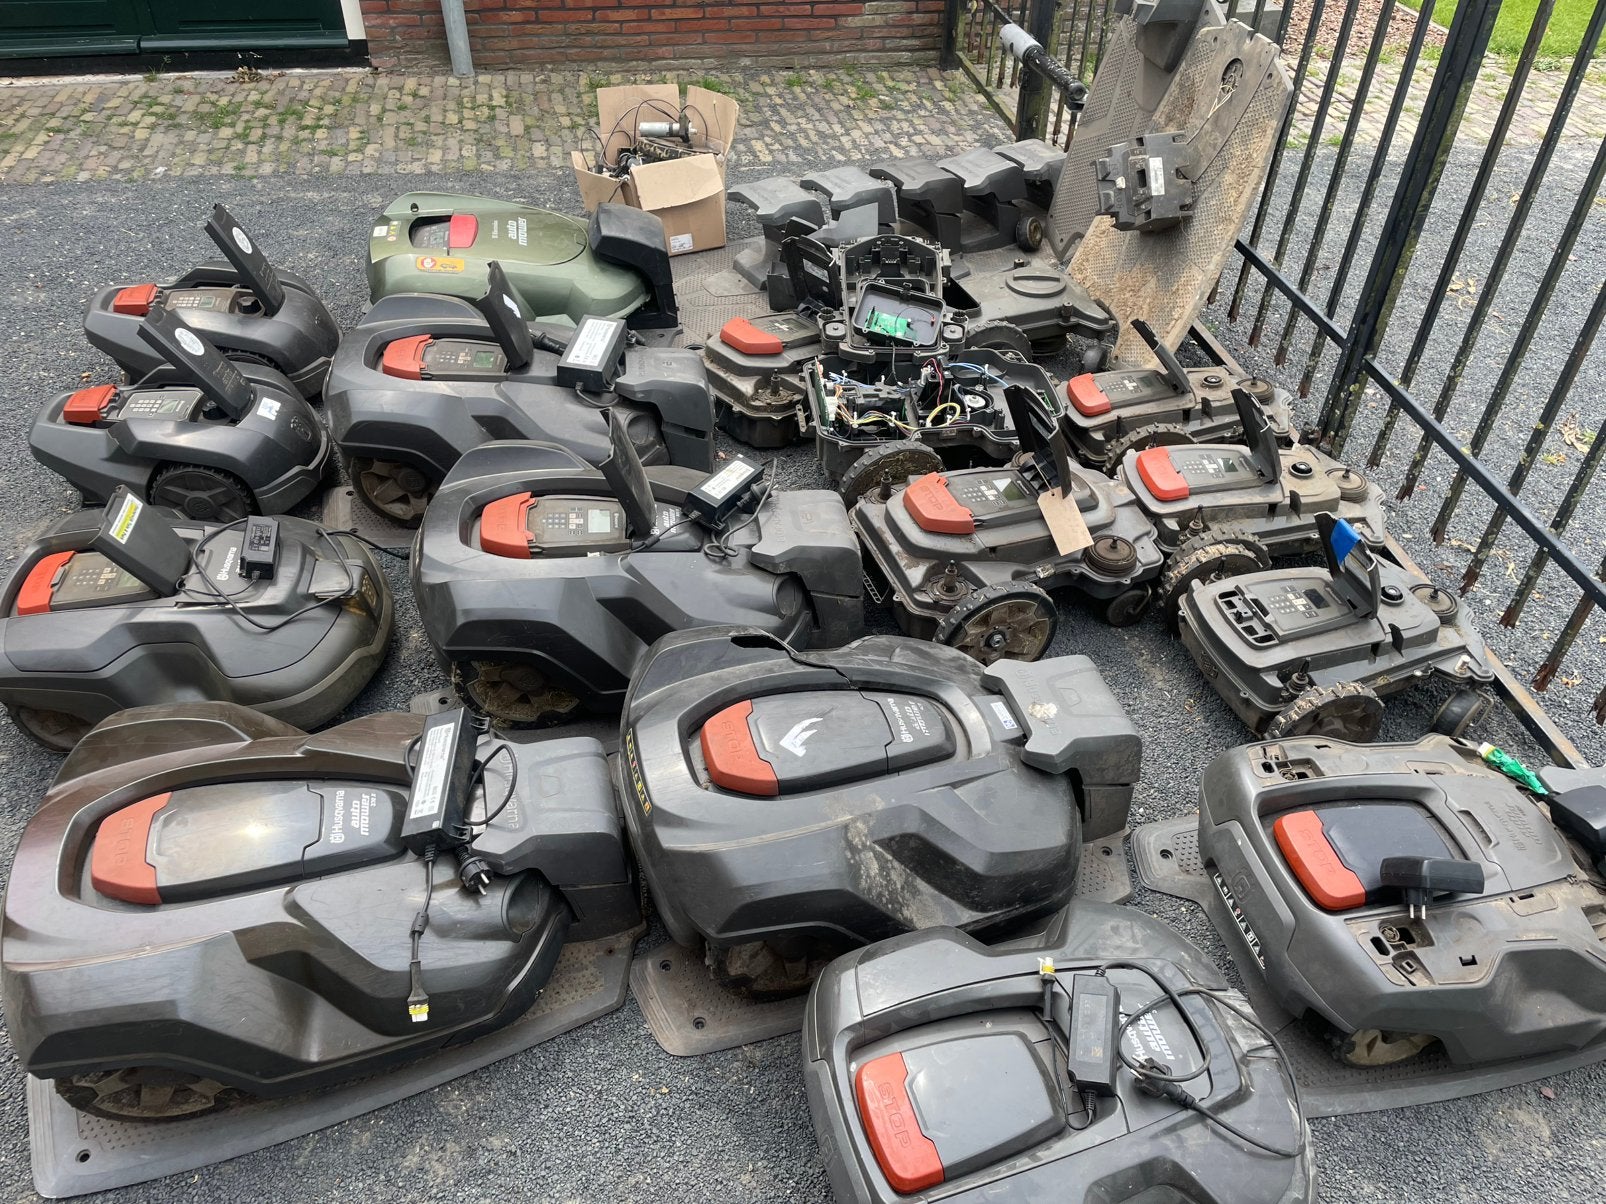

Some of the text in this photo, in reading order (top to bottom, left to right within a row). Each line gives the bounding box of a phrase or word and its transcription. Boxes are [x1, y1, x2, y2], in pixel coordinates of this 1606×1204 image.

[508, 220, 518, 239] auto
[517, 216, 528, 246] mower
[333, 789, 345, 833] Husqvarna
[351, 800, 360, 829] auto
[359, 793, 370, 836] mower
[877, 1081, 909, 1149] STOP
